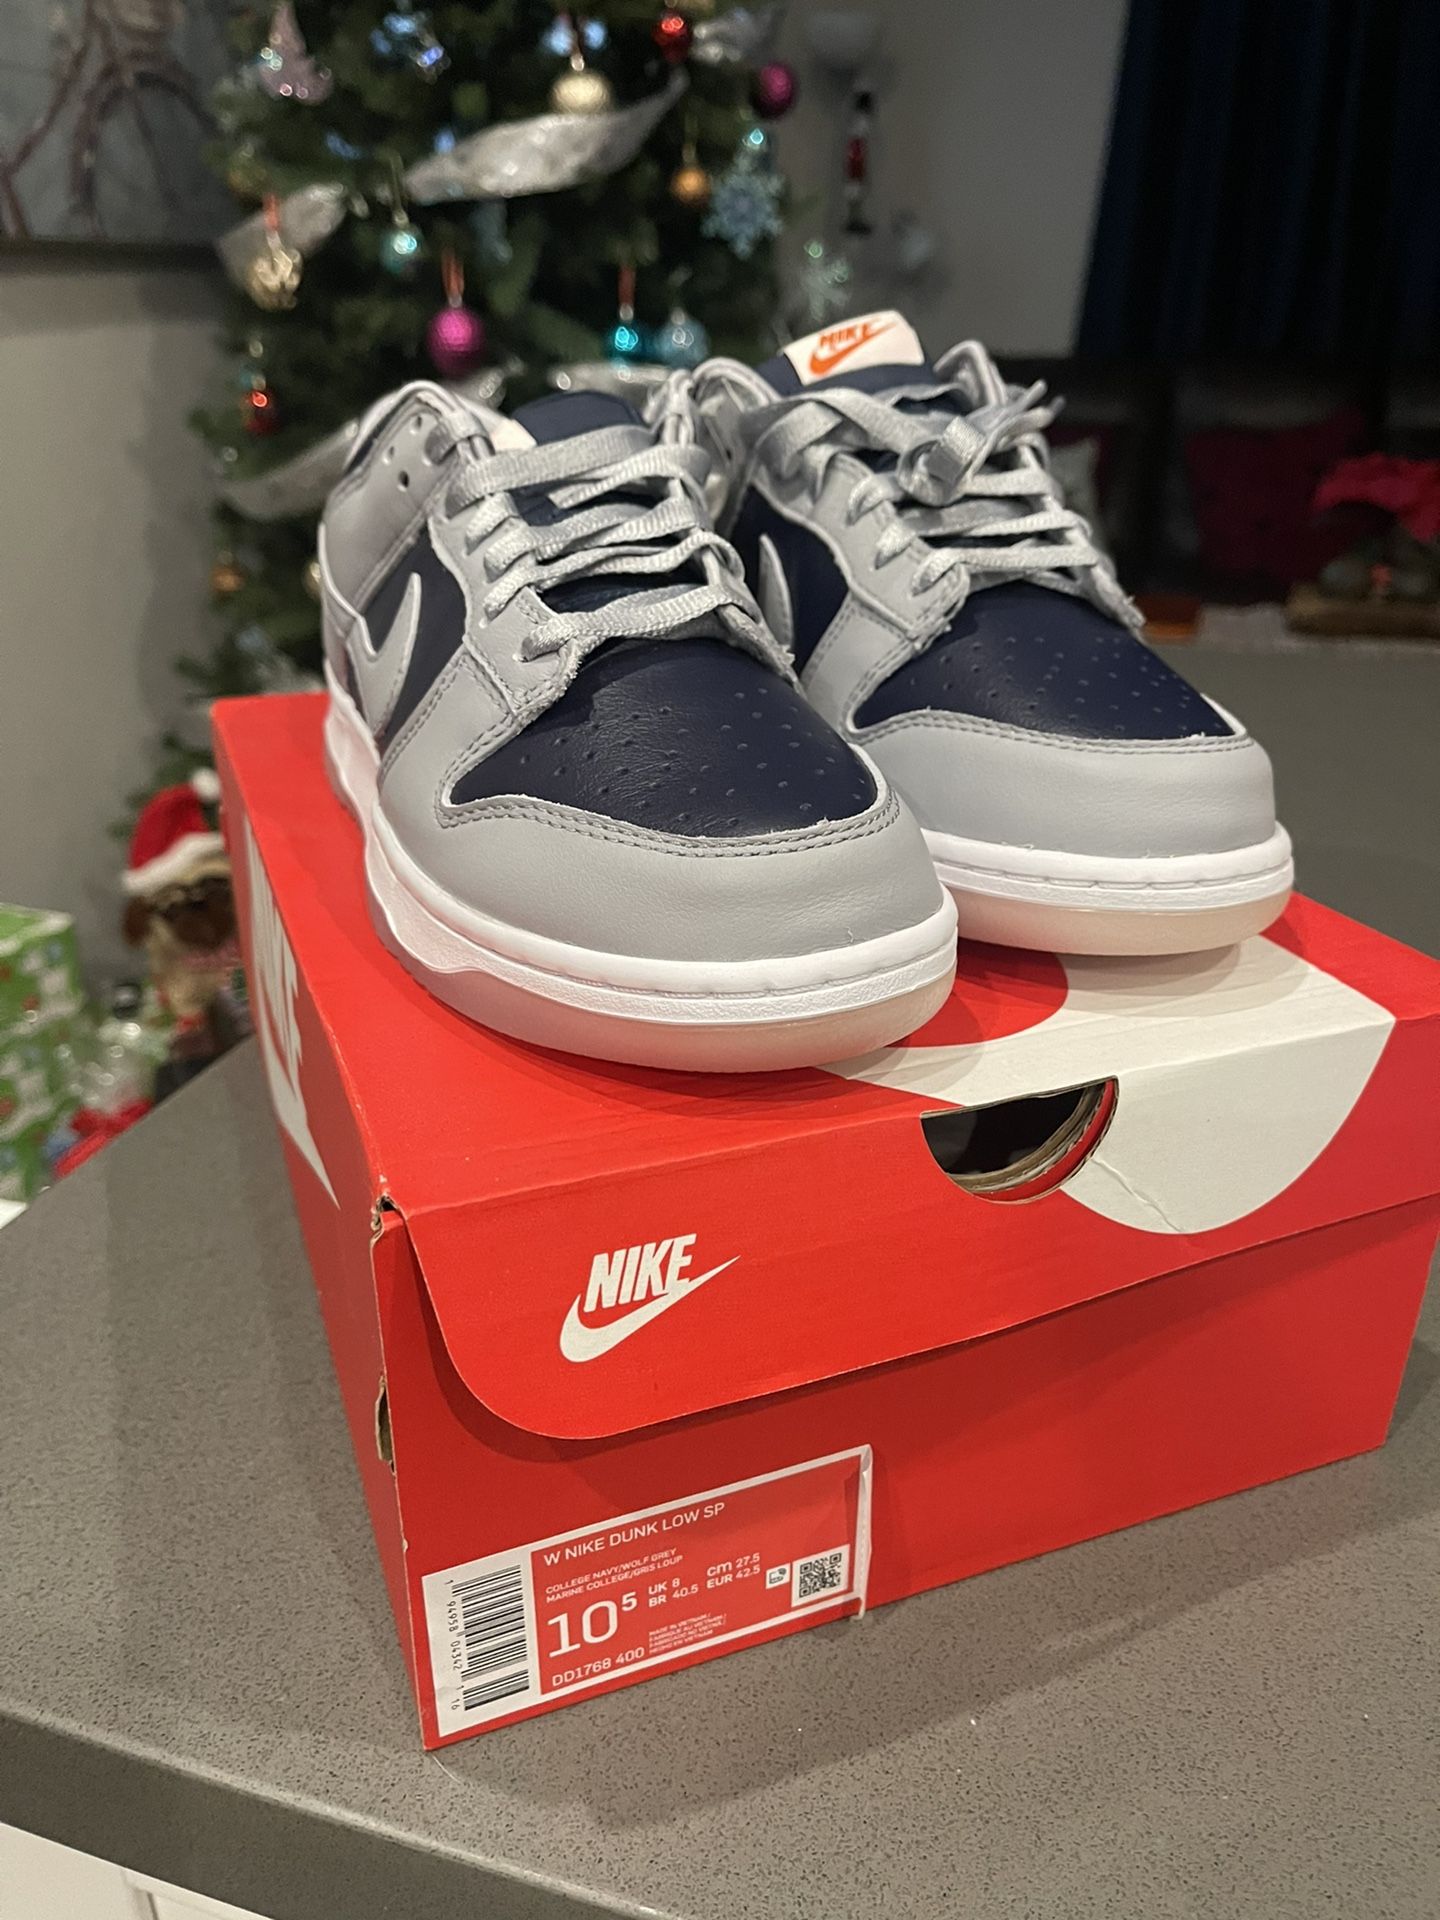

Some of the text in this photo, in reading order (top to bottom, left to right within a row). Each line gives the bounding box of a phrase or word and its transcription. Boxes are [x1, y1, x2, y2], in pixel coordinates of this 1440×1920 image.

[583, 1233, 697, 1313] NIKE
[543, 1502, 725, 1566] W NIKE DUNK LOW SP
[545, 1548, 677, 1595] COLLEGE NAVY/WOLF GREY
[546, 1555, 683, 1603] MARINE COLLEGE/GRIS LOUP
[707, 1552, 761, 1577] cm 27.5
[707, 1564, 761, 1589] EUR 42.5
[648, 1577, 681, 1595] UK 8
[648, 1584, 699, 1608] BR 40.5
[446, 1600, 459, 1633] 94958
[450, 1640, 463, 1671] 04342
[552, 1657, 612, 1687] DD1768
[615, 1646, 645, 1665] 400
